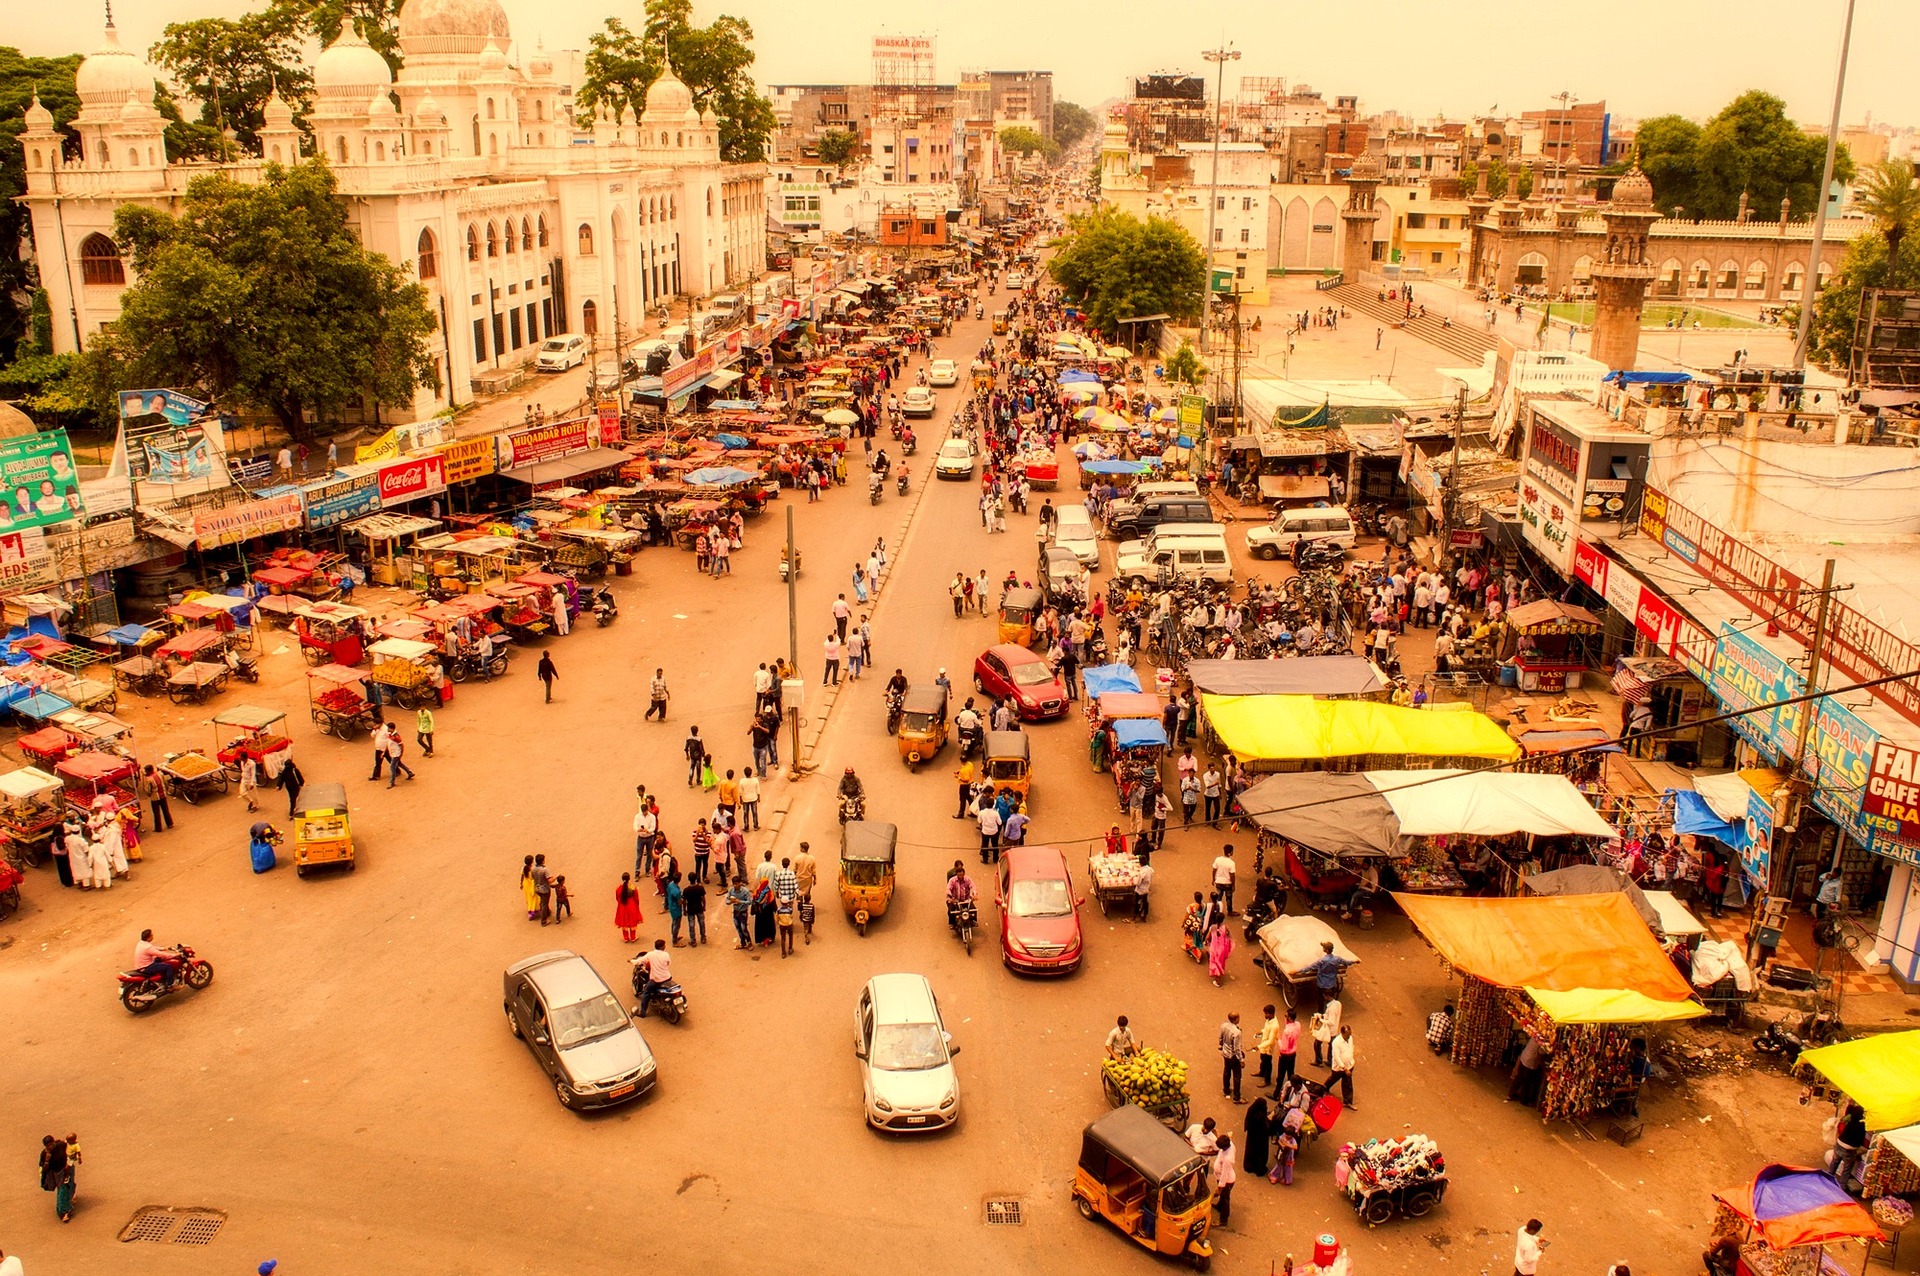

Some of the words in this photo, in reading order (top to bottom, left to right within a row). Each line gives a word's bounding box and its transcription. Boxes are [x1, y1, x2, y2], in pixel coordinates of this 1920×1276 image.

[875, 39, 909, 47] BHASKAR
[912, 40, 929, 48] ARTS
[513, 429, 559, 447] MUQADDAR
[561, 423, 585, 436] HOTEL
[443, 440, 488, 460] MUNNU
[1534, 424, 1580, 475] NIMRAH
[308, 489, 324, 503] ABUL
[354, 473, 377, 489] BAKERY
[201, 513, 251, 531] SADDAM
[1665, 499, 1703, 546] FARASHA
[1702, 523, 1725, 561] CAFE
[1723, 541, 1732, 565] &
[1731, 541, 1774, 588] BAKERY
[1796, 579, 1842, 633] FAMLY
[1723, 640, 1777, 689] SHAADAN
[1714, 652, 1778, 713] PEARLS
[1869, 777, 1919, 806] CAFE
[1865, 813, 1897, 832] VEG
[1883, 801, 1919, 825] IRA
[1872, 838, 1918, 865] PEARL
